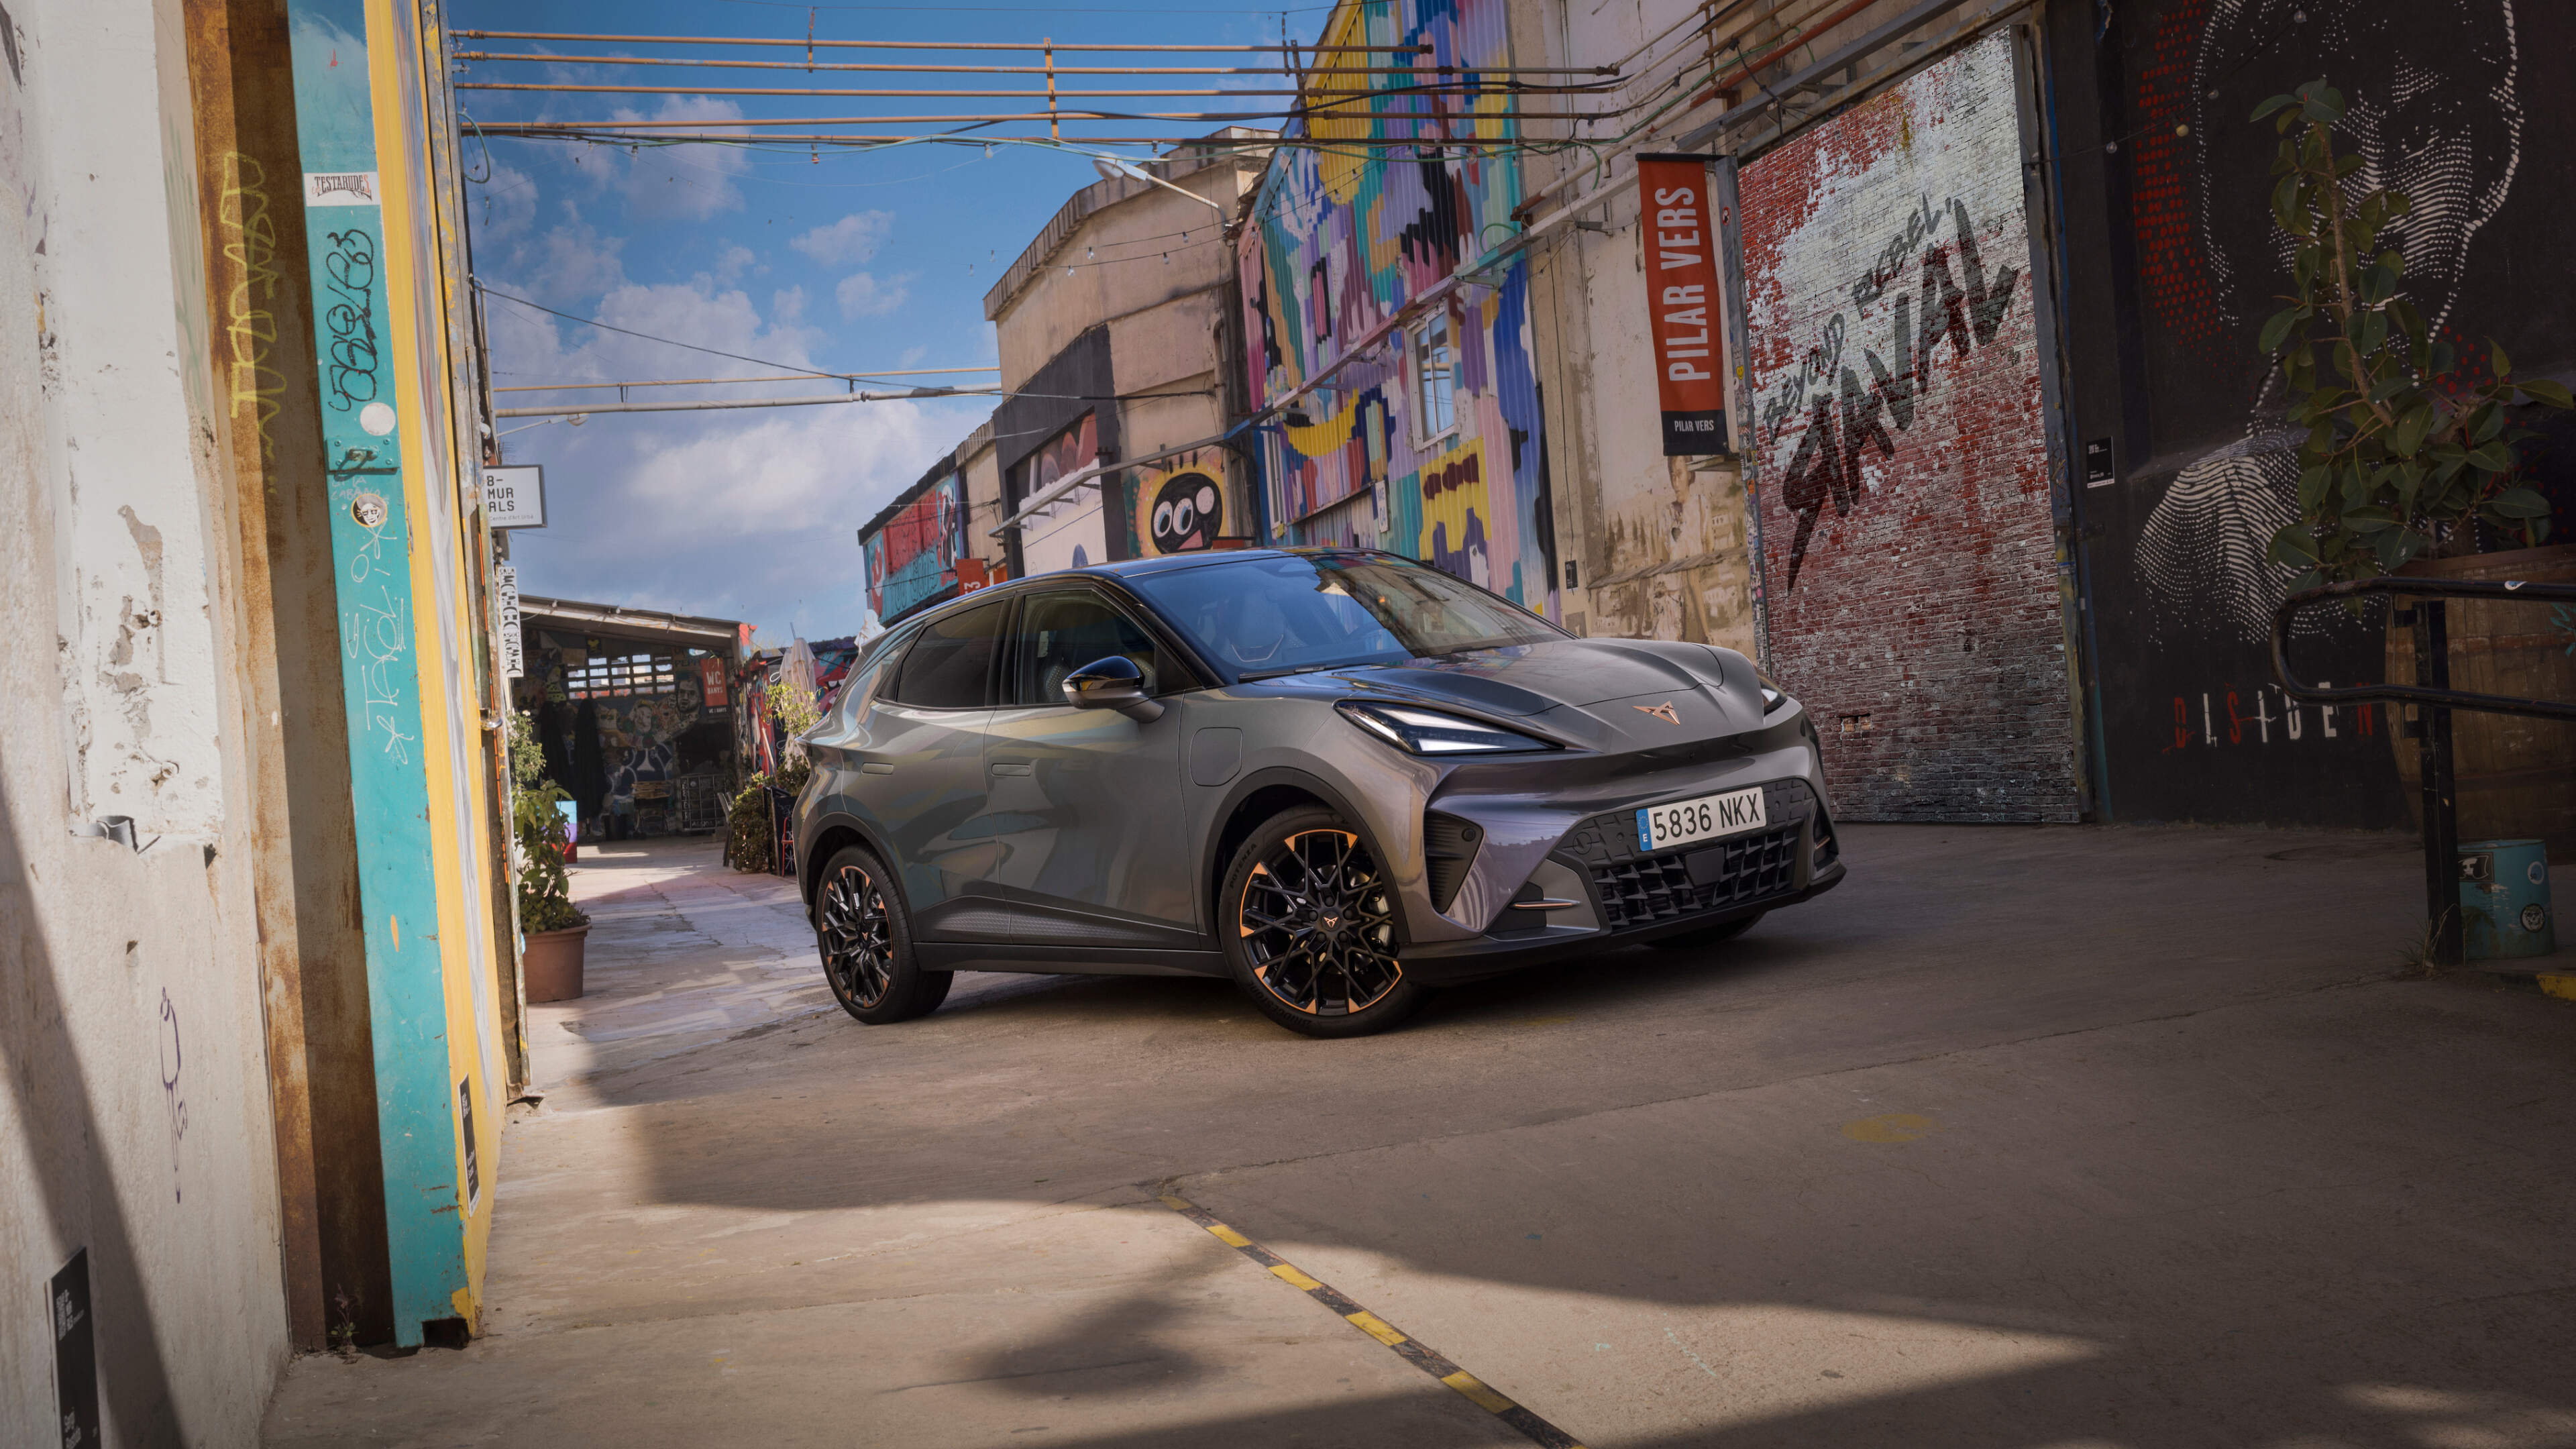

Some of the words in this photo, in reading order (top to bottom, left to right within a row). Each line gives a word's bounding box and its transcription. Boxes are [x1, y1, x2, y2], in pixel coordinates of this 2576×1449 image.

[315, 174, 370, 193] TESTARUDES
[1655, 187, 1701, 270] VERS
[1663, 284, 1711, 381] PILAR
[1764, 313, 1845, 445] BEYOND
[1674, 421, 1694, 432] PILAR
[1695, 419, 1715, 431] VERS
[487, 476, 503, 486] B-
[488, 488, 514, 499] MUR
[488, 500, 515, 513] ALS
[706, 671, 721, 686] WC
[707, 686, 723, 694] BANYS
[1653, 804, 1711, 841] 5836
[1719, 794, 1760, 828] NKX
[1642, 833, 1648, 842] E
